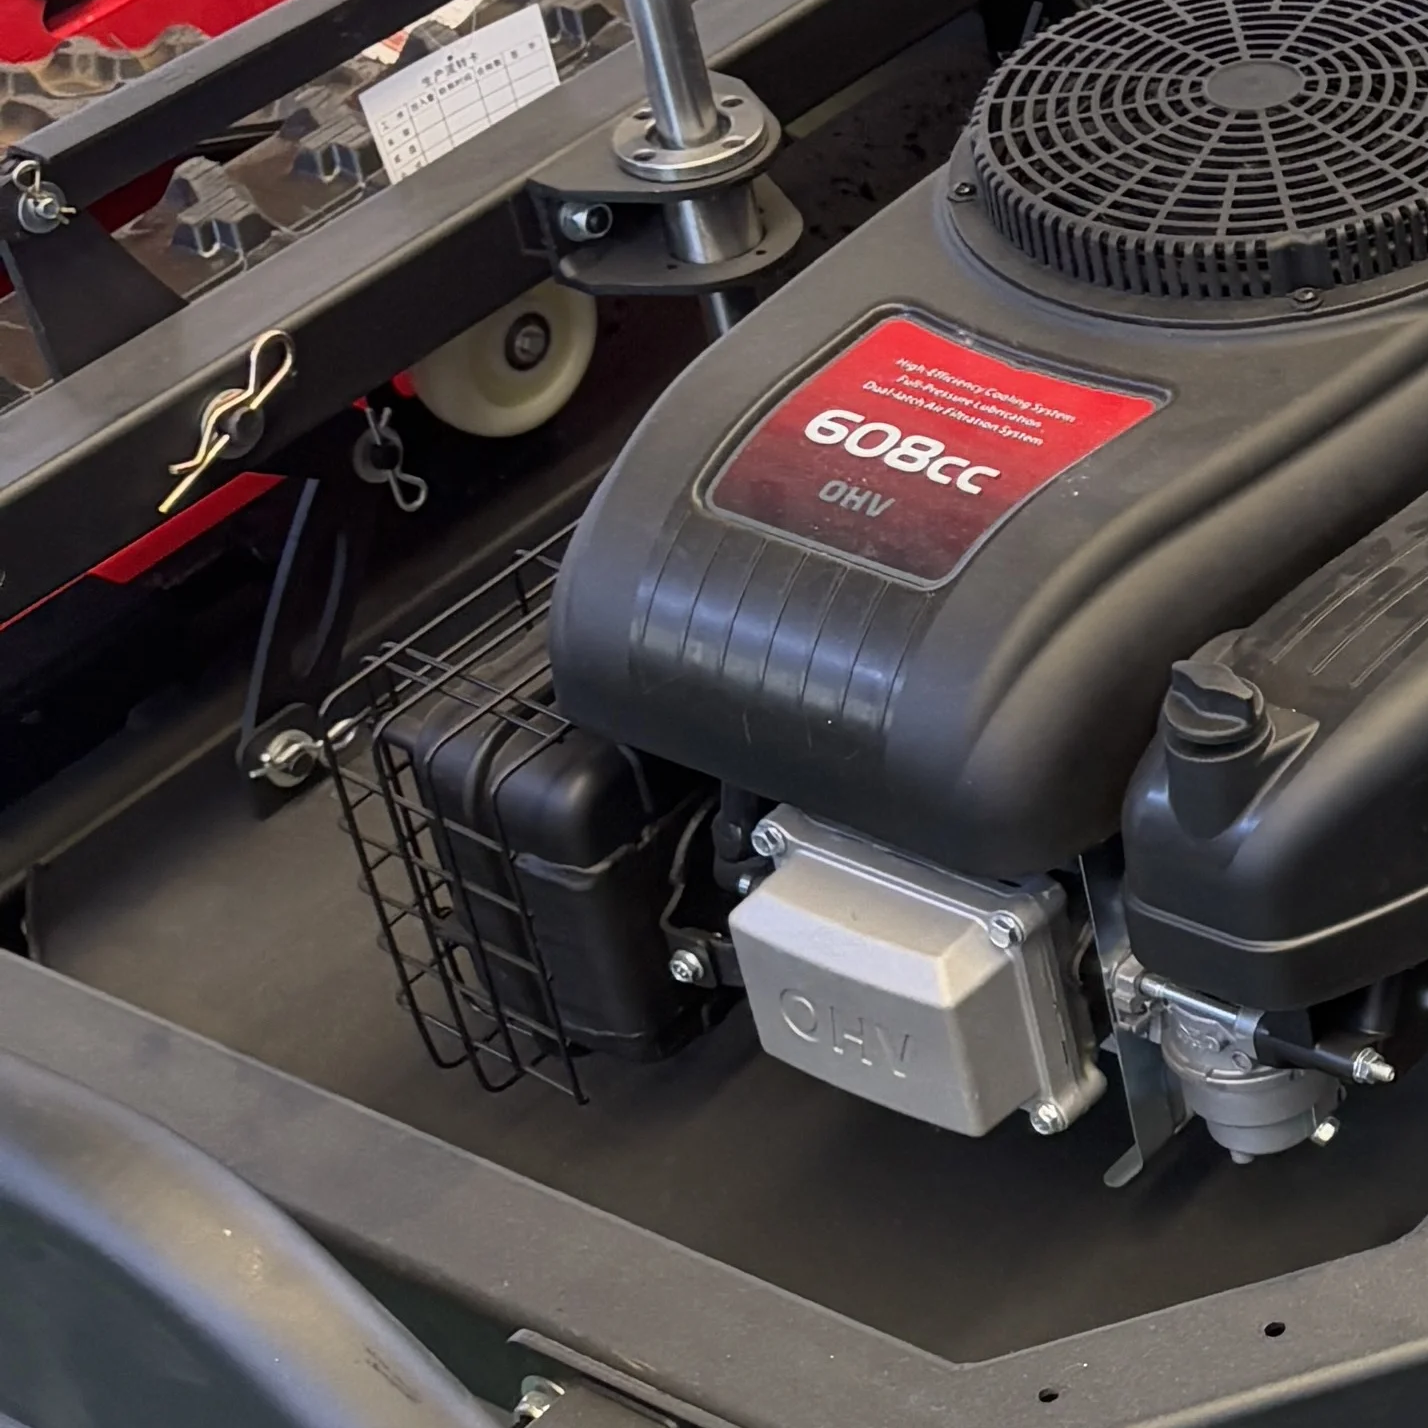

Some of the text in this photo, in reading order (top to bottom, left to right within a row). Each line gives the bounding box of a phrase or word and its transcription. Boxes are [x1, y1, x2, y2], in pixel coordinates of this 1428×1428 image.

[895, 357, 984, 395] High-Efficiency
[1029, 402, 1077, 425] System
[895, 373, 1043, 429] Full-Pressure Lubrication
[803, 408, 1002, 495] 608cc
[998, 423, 1045, 448] System
[817, 478, 897, 518] OHV
[778, 987, 910, 1078] OHV
